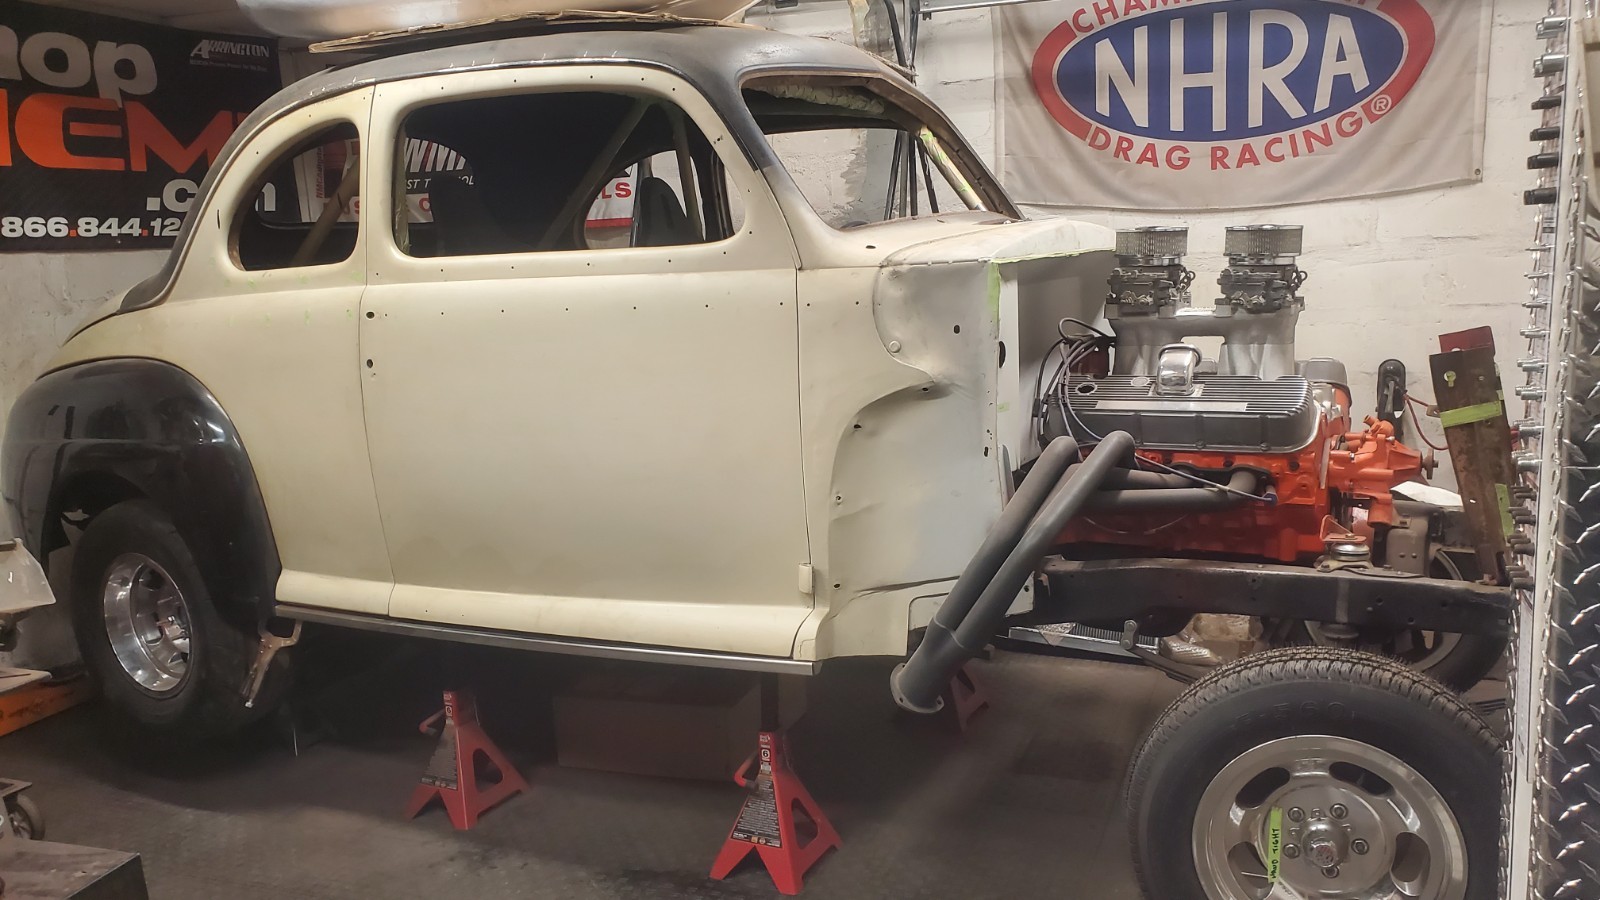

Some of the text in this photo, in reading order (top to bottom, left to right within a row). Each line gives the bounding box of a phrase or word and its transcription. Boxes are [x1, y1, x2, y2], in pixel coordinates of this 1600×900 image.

[1095, 9, 1371, 132] NHRA
[0, 88, 251, 174] EM
[1088, 126, 1191, 171] DRAG
[1210, 110, 1364, 171] RACING
[1, 216, 183, 238] 866.844.12
[1270, 828, 1280, 879] HAND TIGHT
